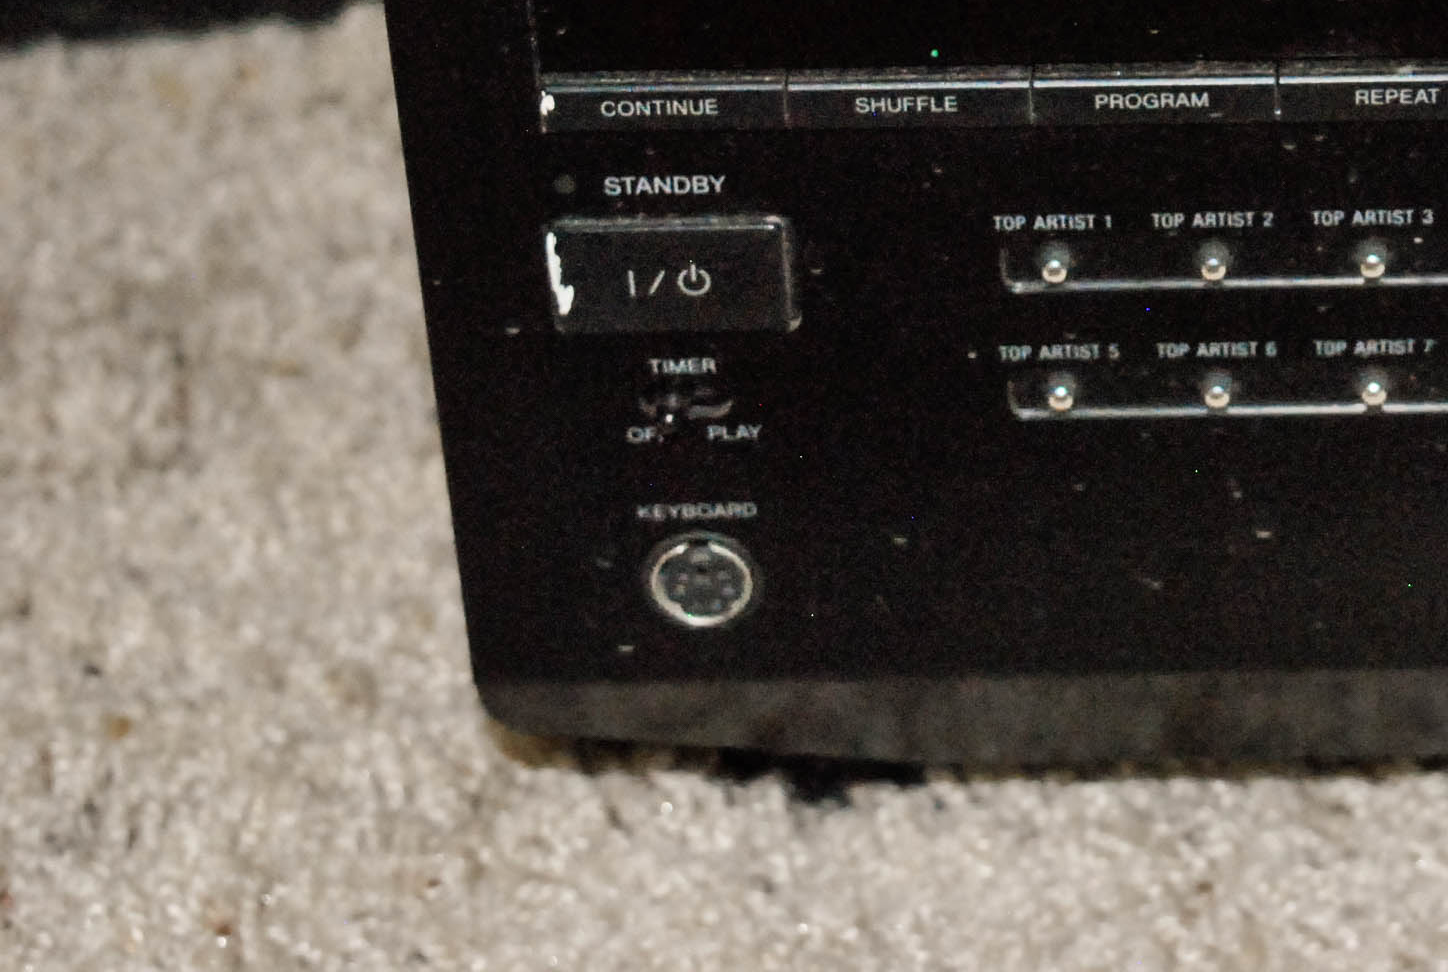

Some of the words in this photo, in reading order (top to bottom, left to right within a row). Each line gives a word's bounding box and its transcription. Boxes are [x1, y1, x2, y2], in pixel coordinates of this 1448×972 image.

[854, 95, 958, 115] SHUFFLE
[1094, 91, 1211, 111] PROGRAM
[1354, 88, 1439, 106] REPEAT
[600, 98, 719, 118] CONTINUE
[603, 175, 727, 196] STANDBY
[993, 215, 1027, 230] TOP
[1033, 215, 1095, 230] ARTIST
[1103, 215, 1113, 228] 1
[1151, 213, 1185, 228] TOP
[1192, 213, 1254, 227] ARTIST
[1262, 212, 1275, 227] 2
[1311, 210, 1346, 226] TOP
[1352, 209, 1414, 225] ARTIST
[1421, 209, 1434, 224] 3
[999, 345, 1032, 360] TOP
[1038, 344, 1099, 359] ARTIST
[1108, 344, 1121, 359] 5
[1156, 342, 1190, 357] TOP
[1196, 342, 1257, 356] ARTIST
[1264, 341, 1277, 357] 6
[1315, 340, 1348, 355] TOP
[1353, 339, 1415, 354] ARTIST
[1422, 339, 1435, 353] 7
[649, 357, 717, 374] TIMER
[706, 425, 763, 442] PLAY
[636, 502, 758, 521] KEYBOARD
